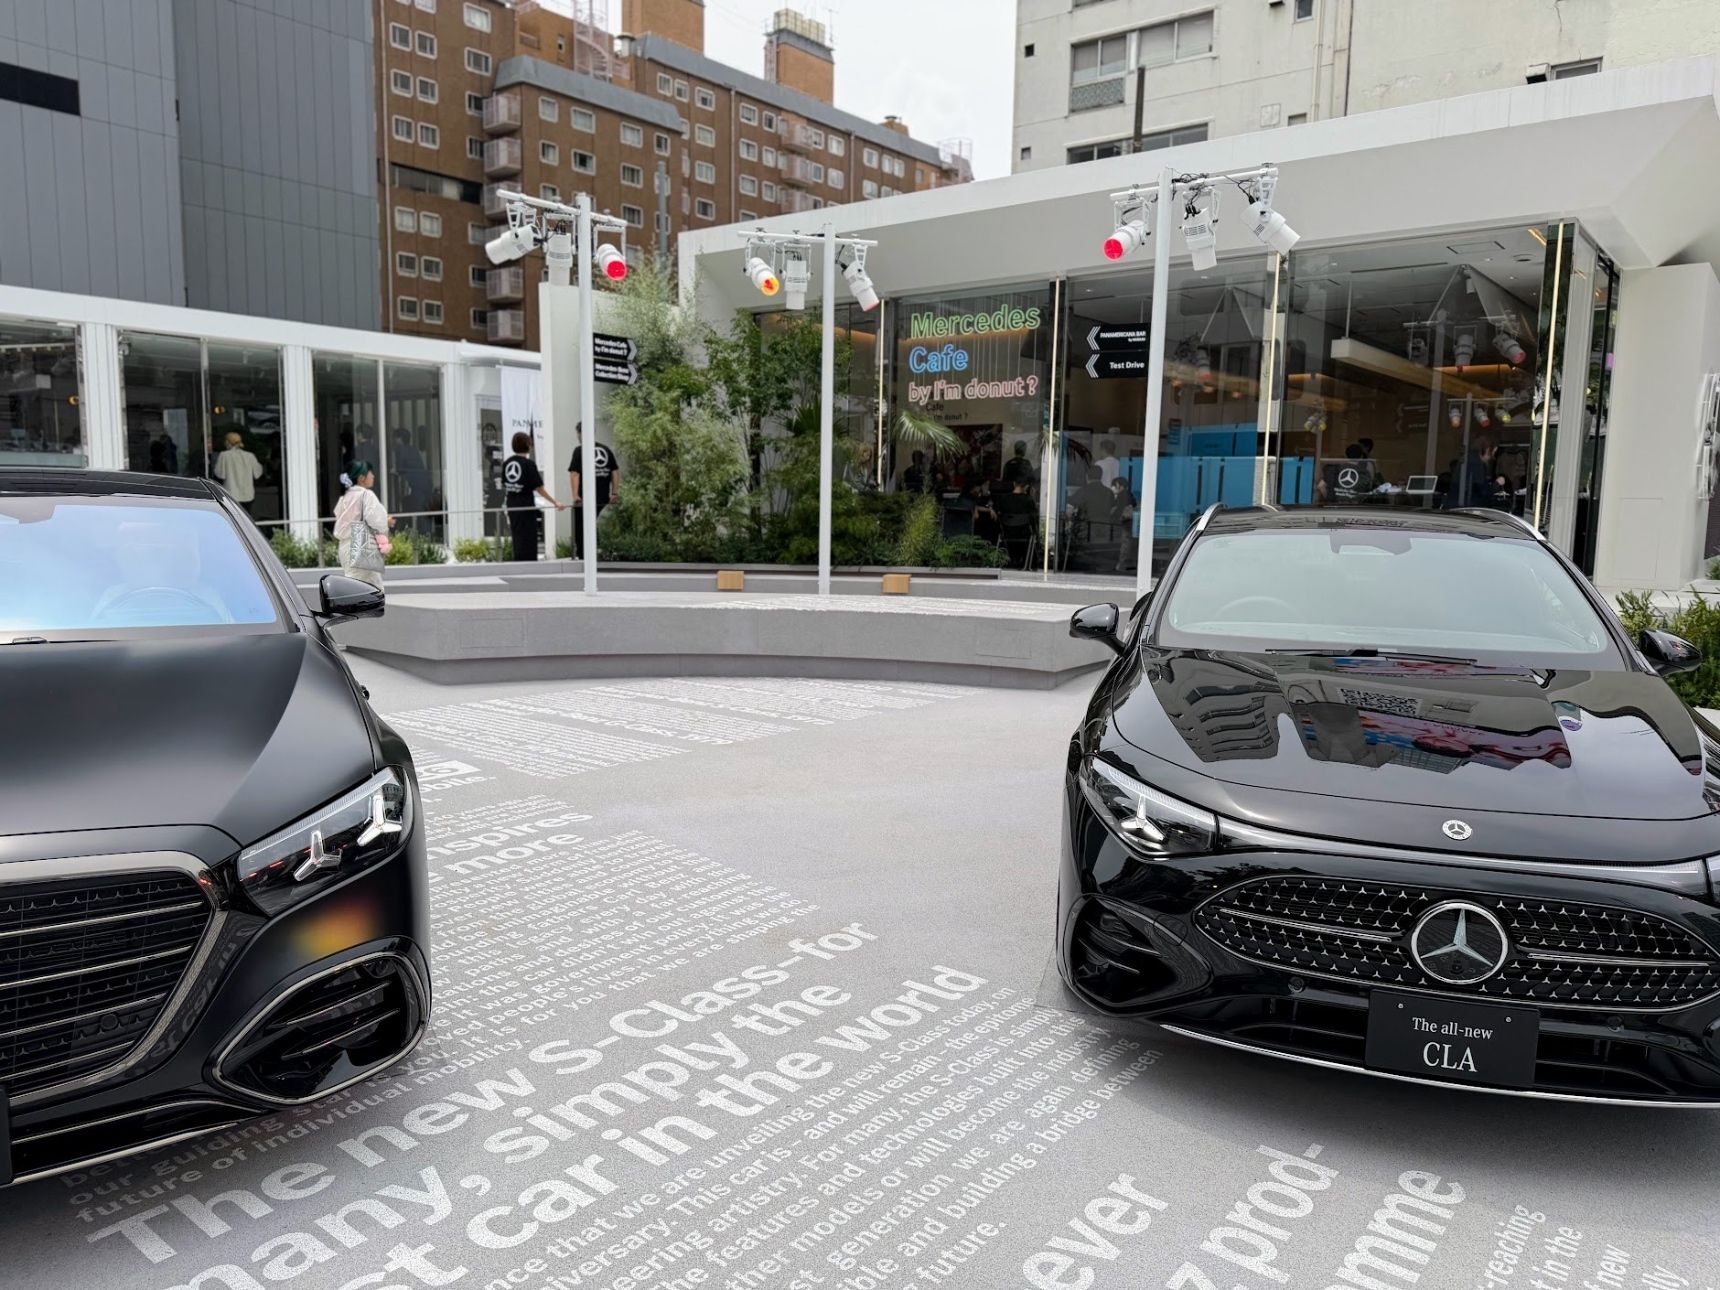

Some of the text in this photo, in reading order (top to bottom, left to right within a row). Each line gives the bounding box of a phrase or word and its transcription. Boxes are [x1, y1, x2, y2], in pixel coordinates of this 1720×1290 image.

[910, 344, 968, 373] Cafe
[911, 304, 1040, 339] Mercedes
[908, 382, 931, 406] by
[934, 380, 961, 400] I'm
[443, 834, 585, 875] more
[365, 1078, 392, 1087] is
[402, 1051, 462, 1075] you.
[461, 1036, 488, 1048] It
[489, 1026, 517, 1036] is
[521, 1009, 556, 1024] for
[563, 992, 605, 1010] you
[608, 972, 654, 990] that
[657, 958, 689, 970] we
[693, 944, 724, 957] are
[726, 916, 795, 943] shaping
[791, 905, 820, 916] the
[581, 966, 641, 986] lives.
[638, 955, 663, 964] In
[663, 918, 759, 955] everything
[754, 908, 780, 918] we
[780, 900, 808, 908] do,
[484, 1032, 749, 1164] simply
[732, 985, 852, 1036] the
[1412, 1017, 1493, 1040] The all-new
[1423, 1042, 1478, 1072] CLA
[77, 1039, 529, 1223] future of individual mobility.
[87, 1166, 335, 1265] The
[339, 1068, 536, 1167] new
[467, 965, 987, 1249] car in the world
[546, 988, 1016, 1258] that we are unveiling the new S-Class today, on
[666, 1184, 731, 1216] This
[729, 1159, 768, 1184] car
[760, 1148, 792, 1162] is
[804, 1111, 848, 1139] and
[841, 1090, 884, 1114] will
[878, 1056, 942, 1093] remain
[945, 1033, 979, 1050] the
[974, 998, 1034, 1034] epitome
[706, 1017, 1083, 1267] features and technologies built into this
[708, 1172, 807, 1232] artistry.
[798, 1143, 844, 1170] For
[842, 1107, 910, 1145] many,
[898, 1086, 938, 1106] the
[930, 1046, 1000, 1086] S-Class
[988, 1036, 1014, 1047] is
[1010, 1009, 1062, 1038] simply
[789, 1029, 1112, 1252] models or will become the industry
[826, 1174, 954, 1270] generation
[952, 1147, 990, 1170] we
[990, 1120, 1026, 1144] are
[1024, 1086, 1074, 1118] again
[1067, 1040, 1140, 1082] defining
[897, 1050, 1161, 1256] and building a bridge between
[916, 1223, 1006, 1283] future.
[1021, 1172, 1169, 1290] ever
[1199, 1142, 1340, 1284] prod-
[1532, 1259, 1571, 1282] in
[1544, 1226, 1583, 1258] the
[1596, 1244, 1630, 1288] new
